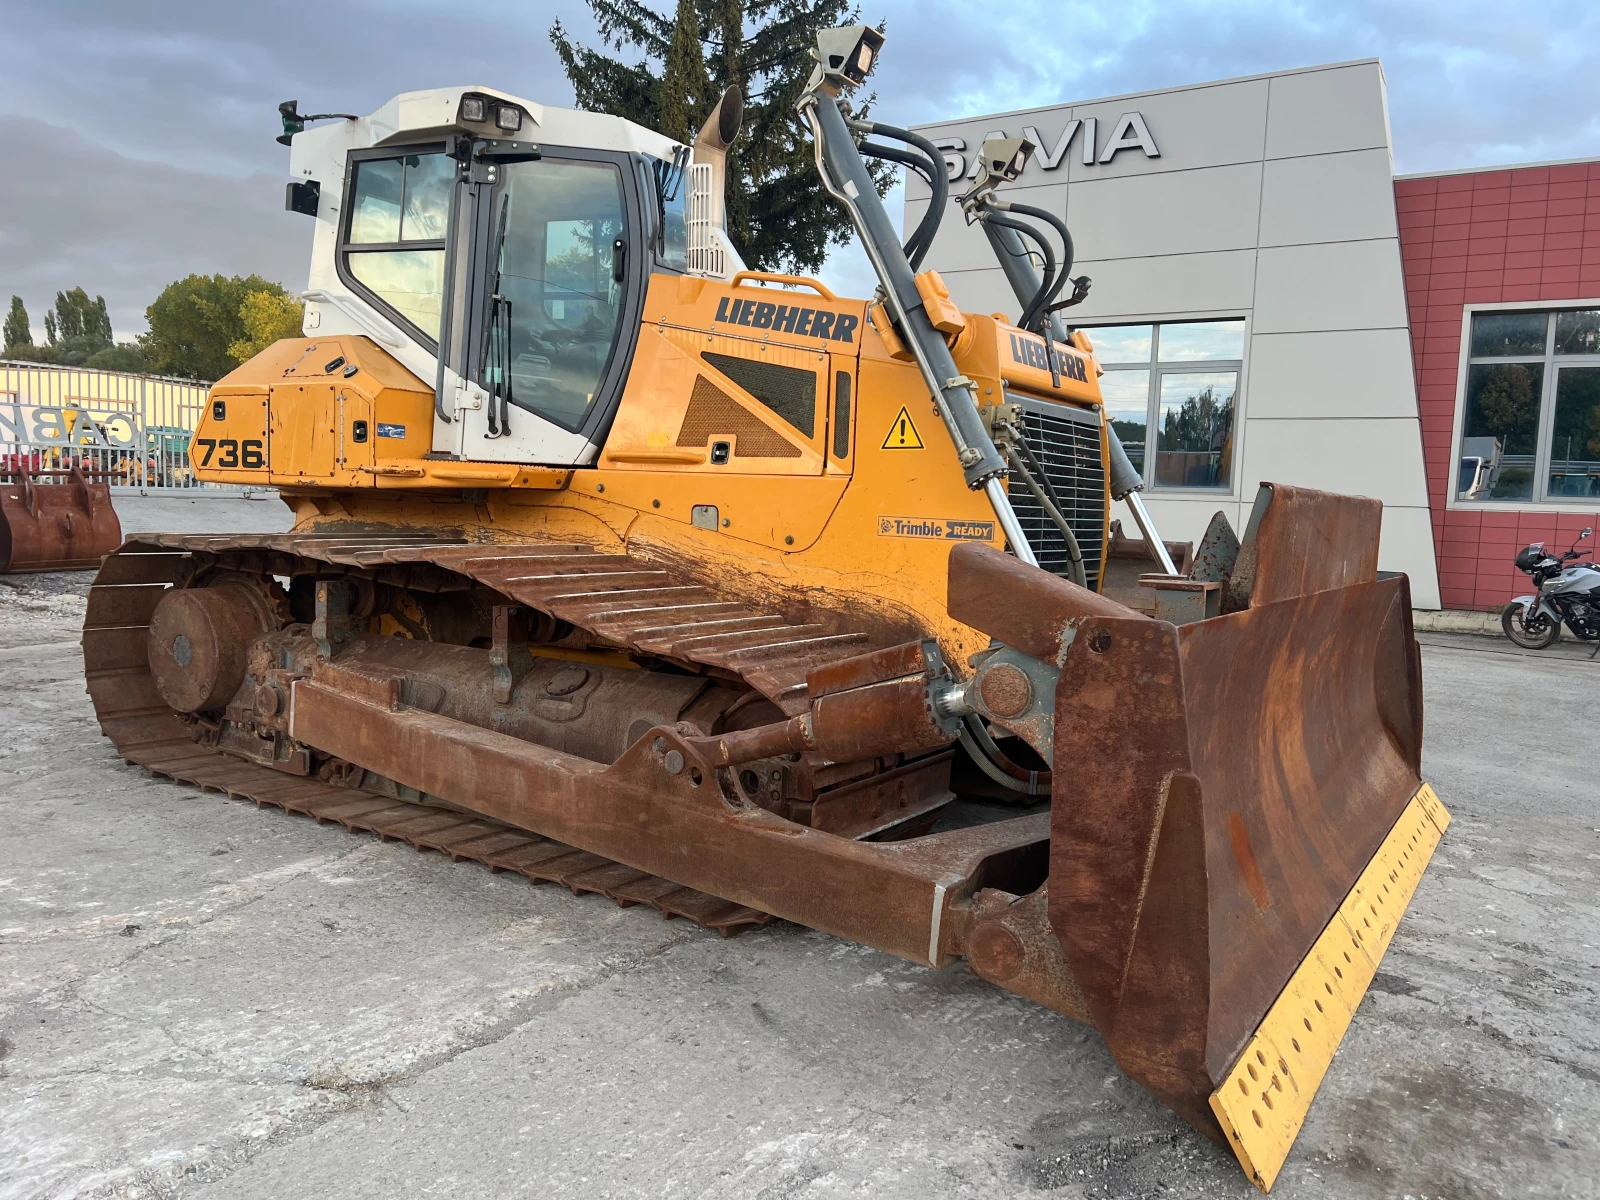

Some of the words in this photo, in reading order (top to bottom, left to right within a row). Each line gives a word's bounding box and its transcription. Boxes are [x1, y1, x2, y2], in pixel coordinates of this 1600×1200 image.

[715, 296, 859, 343] LIEBHERR
[197, 439, 263, 469] 736
[895, 520, 942, 536] Trimble
[953, 525, 989, 537] READY
